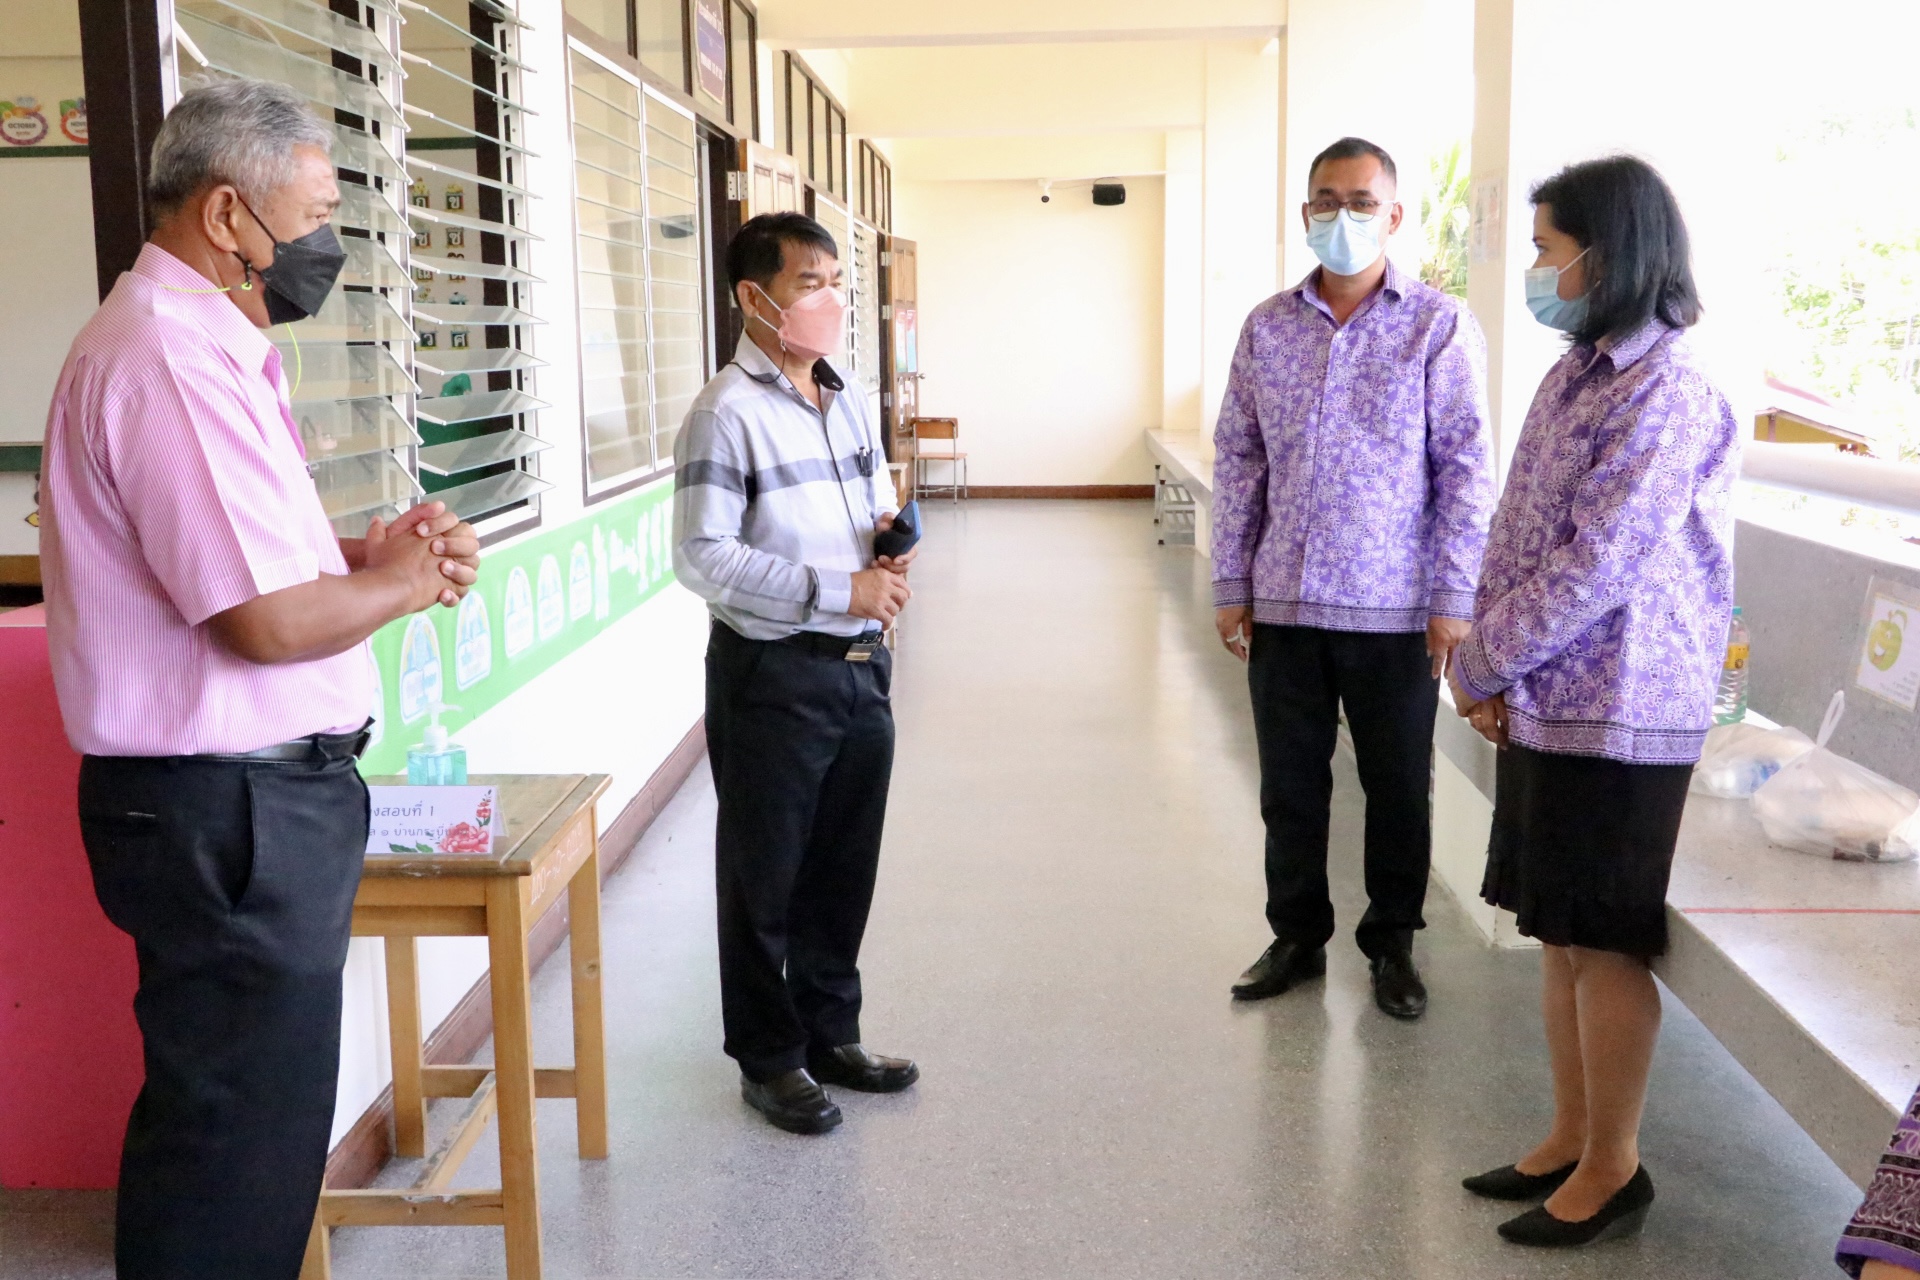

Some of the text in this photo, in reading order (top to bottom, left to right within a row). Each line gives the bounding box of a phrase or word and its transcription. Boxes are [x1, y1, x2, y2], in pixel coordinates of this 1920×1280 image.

[423, 333, 434, 346] ว
[454, 333, 466, 347] ศ
[371, 800, 424, 817] งสอบที่
